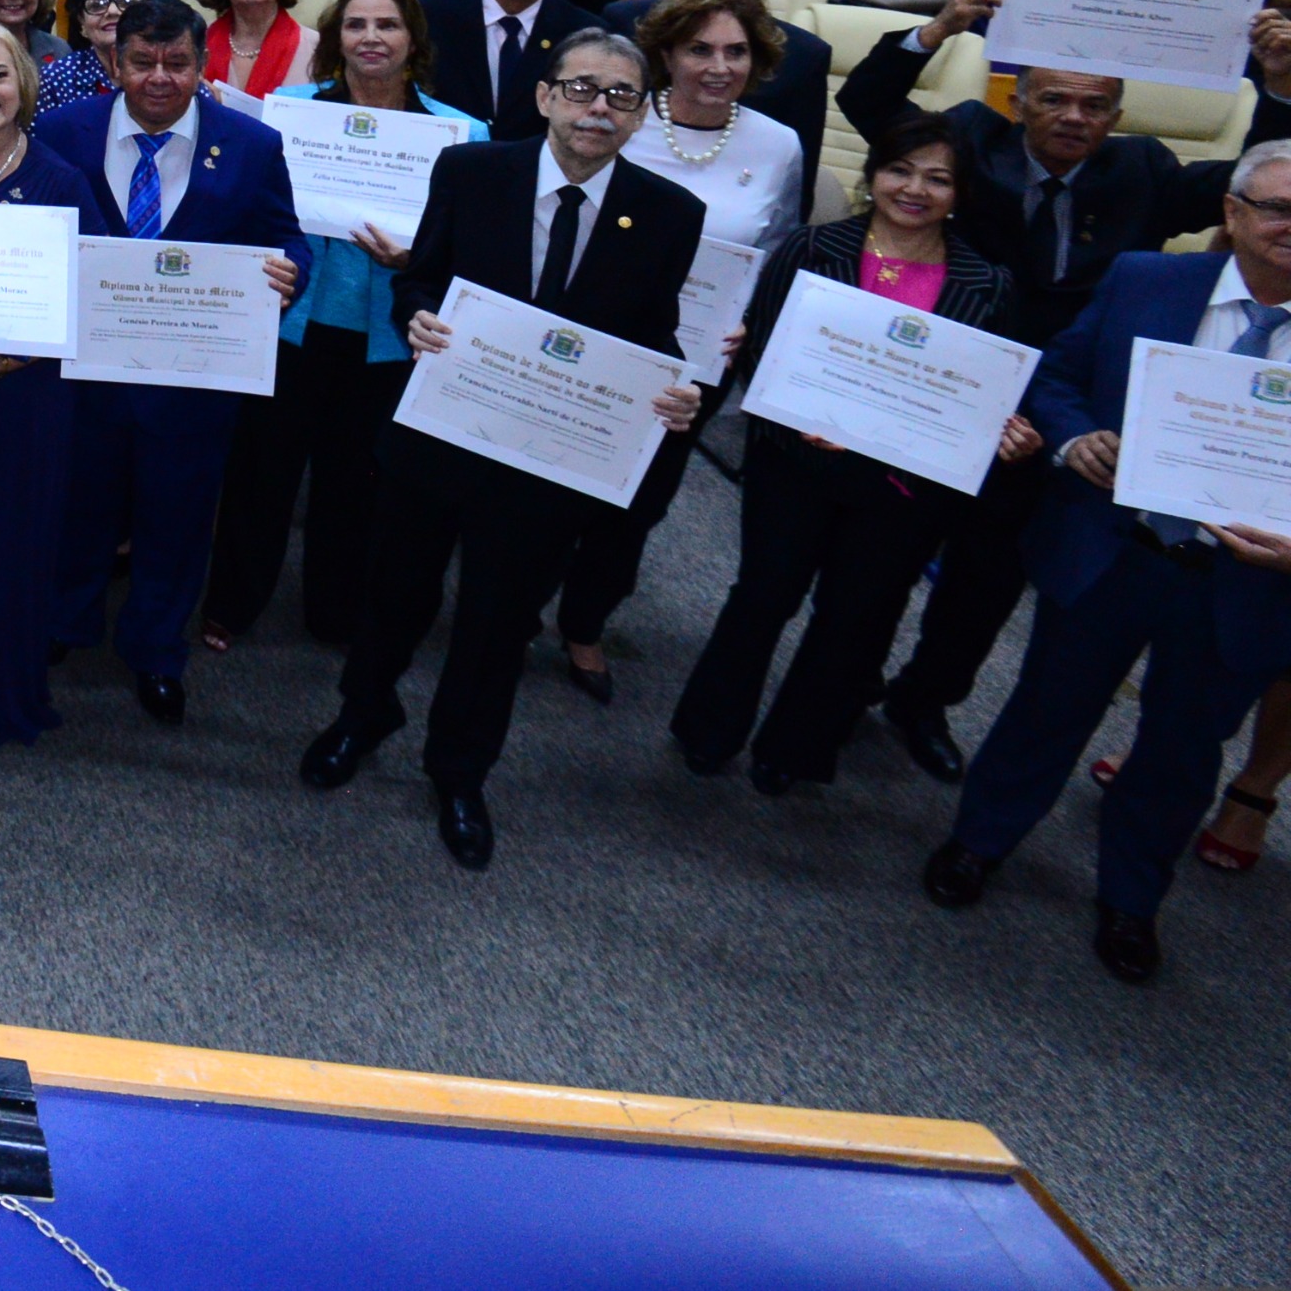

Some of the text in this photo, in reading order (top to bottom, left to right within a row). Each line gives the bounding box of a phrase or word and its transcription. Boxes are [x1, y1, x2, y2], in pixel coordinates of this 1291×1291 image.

[292, 136, 429, 164] Diploma de Honra ao Mérito
[303, 151, 332, 161] Câmara
[335, 155, 371, 166] Municipal
[384, 162, 413, 172] Goiânia
[10, 246, 43, 258] Mérito
[100, 280, 244, 298] Diploma de Honra ao Mérito
[113, 295, 143, 303] Câmara
[147, 296, 184, 306] Municipal
[199, 299, 228, 308] Goiânia
[151, 319, 178, 328] Pereira
[180, 320, 190, 328] de
[192, 321, 218, 330] Morais
[471, 336, 634, 405] Diploma de Honra ao Mérito
[480, 357, 515, 376] Câmara
[519, 370, 561, 393] Municipal
[576, 391, 611, 410] Goiânia
[458, 373, 498, 393] Francisco
[500, 390, 535, 408] Geraldo
[559, 410, 571, 421] de
[572, 415, 612, 436] Carvalho
